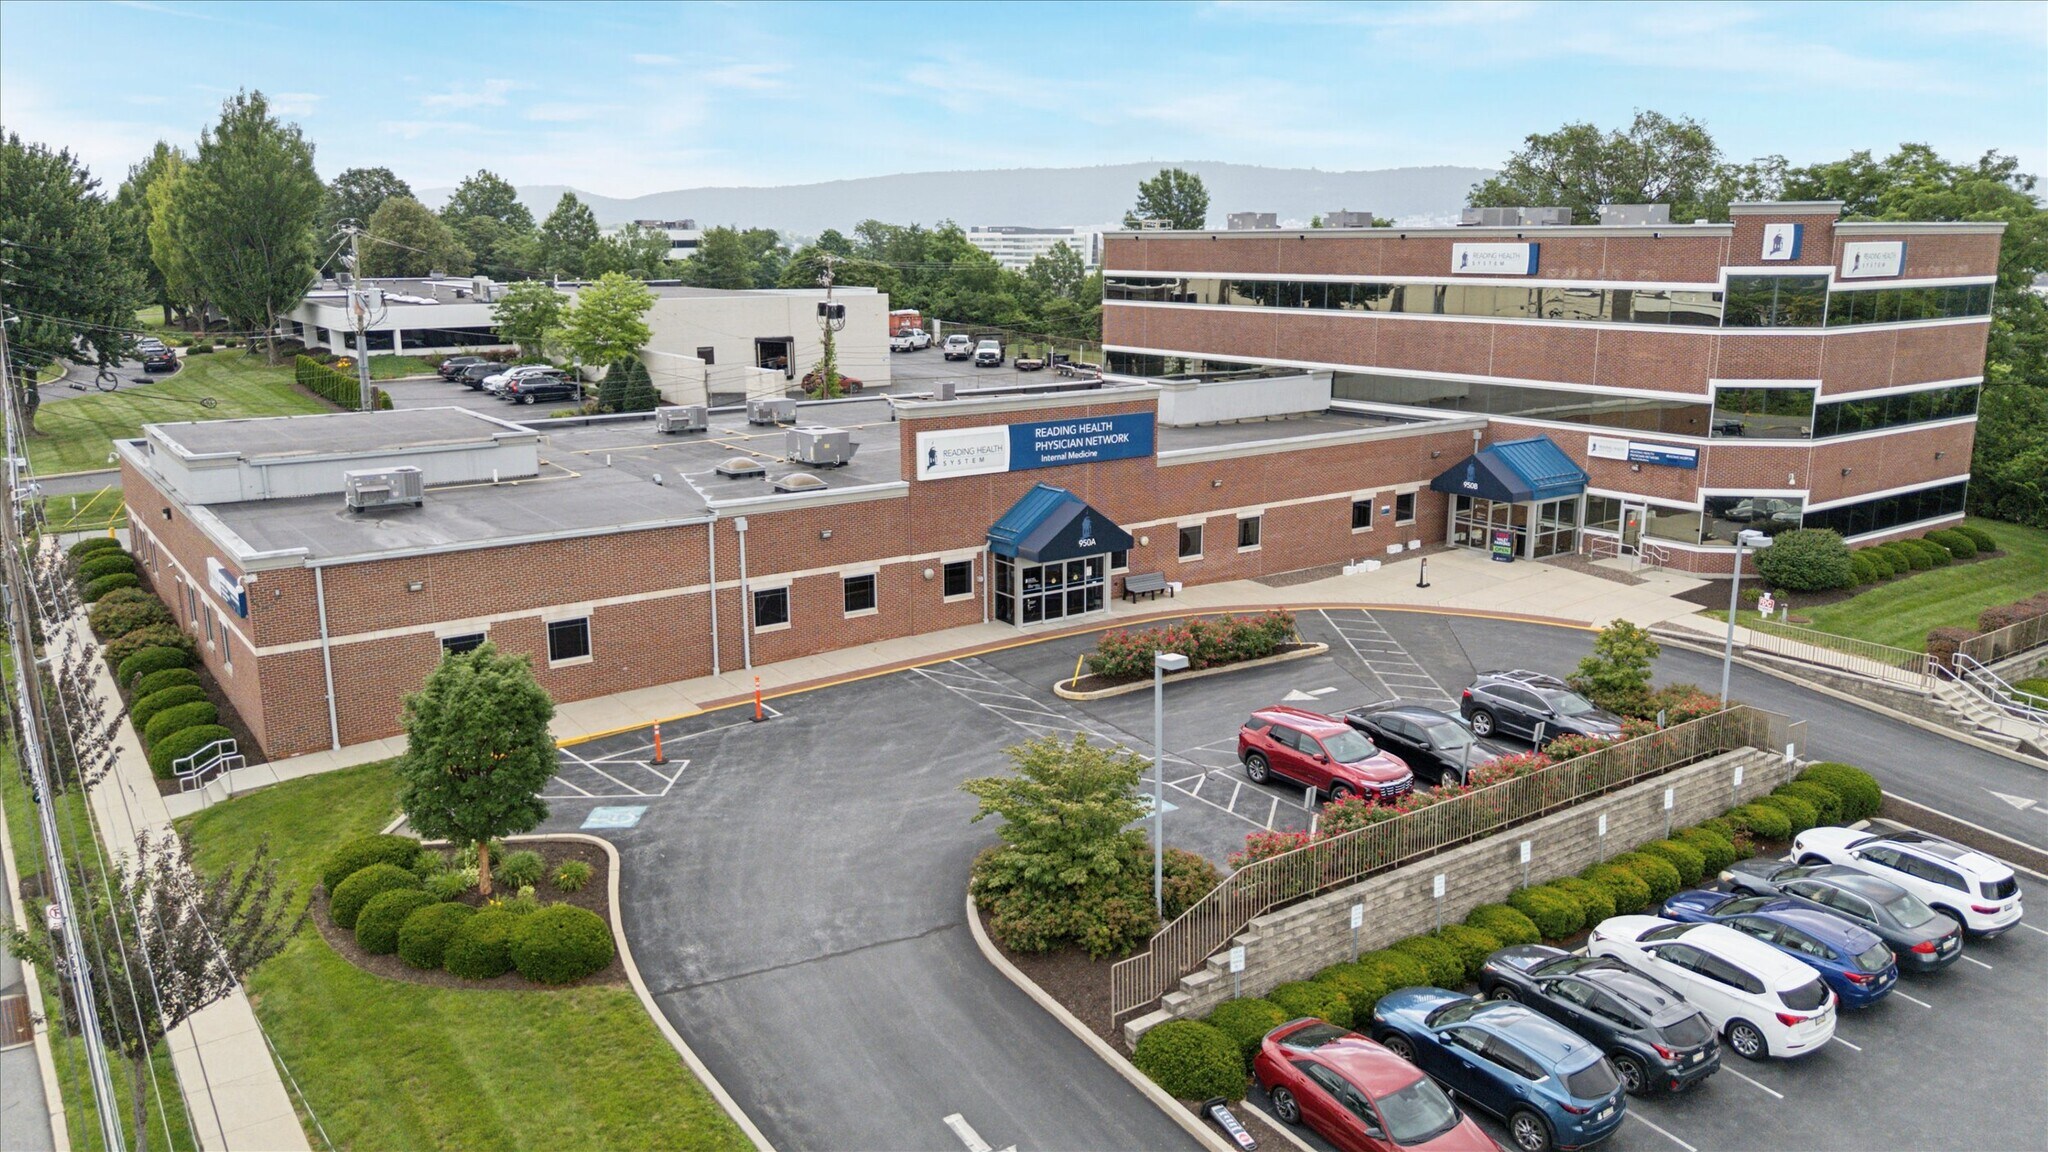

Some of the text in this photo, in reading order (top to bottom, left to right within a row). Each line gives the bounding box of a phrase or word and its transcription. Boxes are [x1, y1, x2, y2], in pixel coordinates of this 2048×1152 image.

[1473, 252, 1497, 260] READING
[1035, 421, 1113, 438] READING HEALTH
[1035, 433, 1130, 451] PHYSICIAN NETWORK
[943, 444, 1003, 457] READING HEALTH
[1041, 449, 1098, 462] Internal Medicine
[943, 456, 985, 466] SYSTEM
[1079, 538, 1097, 548] 950A
